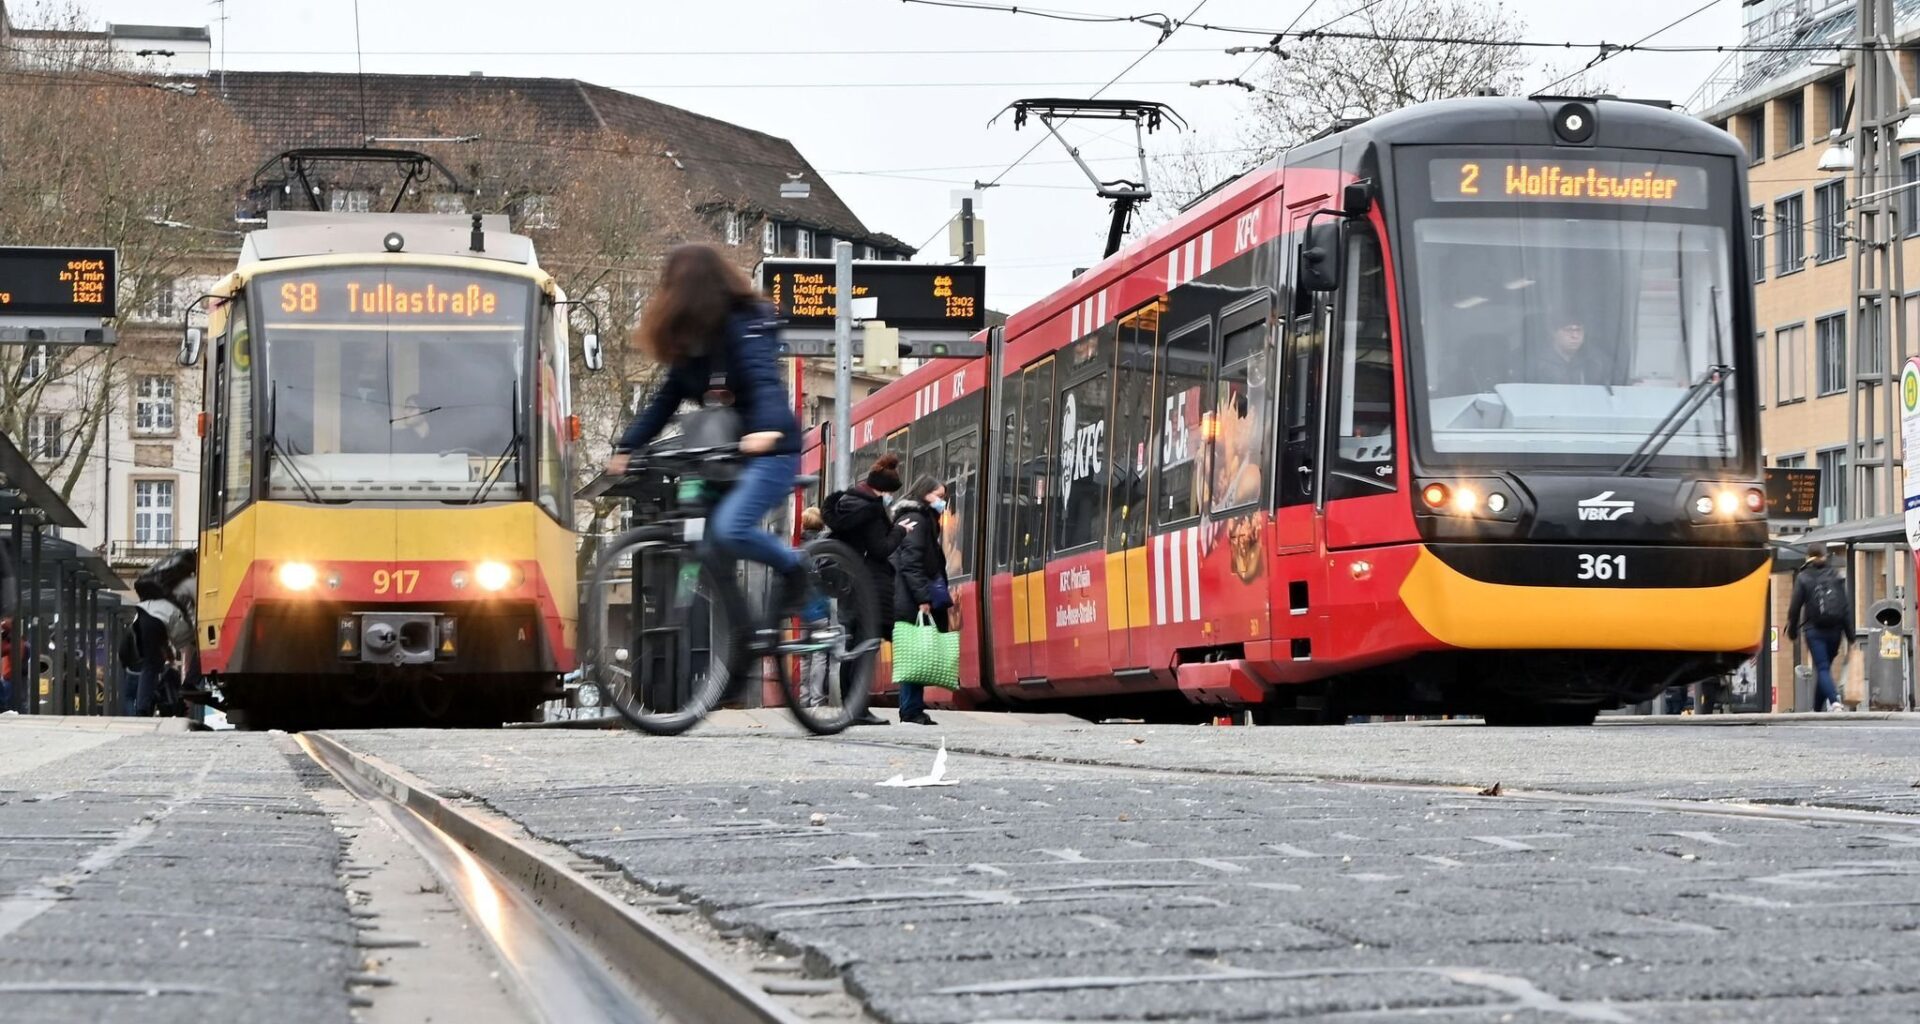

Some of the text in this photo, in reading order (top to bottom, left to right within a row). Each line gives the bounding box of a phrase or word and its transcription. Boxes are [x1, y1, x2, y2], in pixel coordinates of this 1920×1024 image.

[1460, 163, 1677, 199] 2 Wolfartsweier
[1234, 207, 1260, 254] KFC
[67, 260, 104, 271] sofort
[60, 271, 105, 281] in 1 min
[773, 273, 824, 284] 4 Tivoli
[73, 281, 104, 292] 13:04
[773, 284, 869, 295] 2 Wolfartsier
[73, 292, 103, 303] 13:21
[281, 283, 495, 316] S8 Tullastraße
[773, 294, 974, 307] 3 Tivoli 13:02
[792, 305, 838, 317] Wolfarts
[945, 307, 974, 317] 13:13
[952, 369, 966, 399] KFC
[1073, 419, 1105, 481] KFC
[1577, 507, 1611, 521] VBK
[1577, 553, 1627, 580] 361
[373, 569, 420, 595] 917
